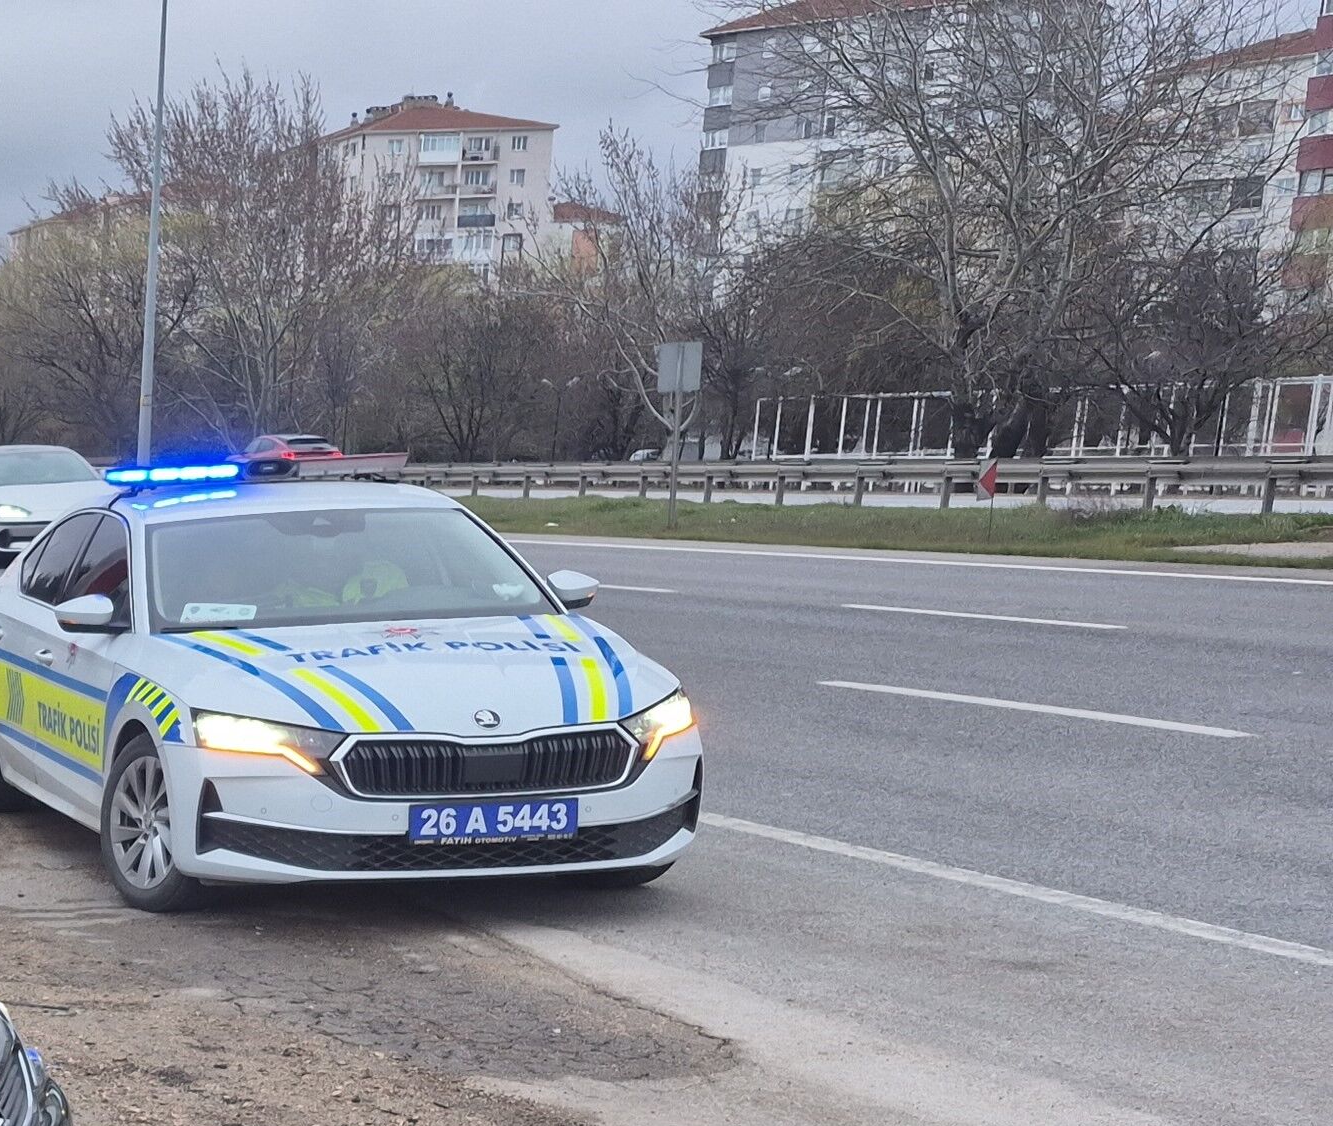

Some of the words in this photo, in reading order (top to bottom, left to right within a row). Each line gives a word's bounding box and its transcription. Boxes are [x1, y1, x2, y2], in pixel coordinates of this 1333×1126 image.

[37, 701, 67, 741] TRAFİK
[69, 715, 100, 756] POLİSİ
[420, 808, 457, 836] 26
[465, 806, 487, 834] A
[496, 803, 568, 833] 5443
